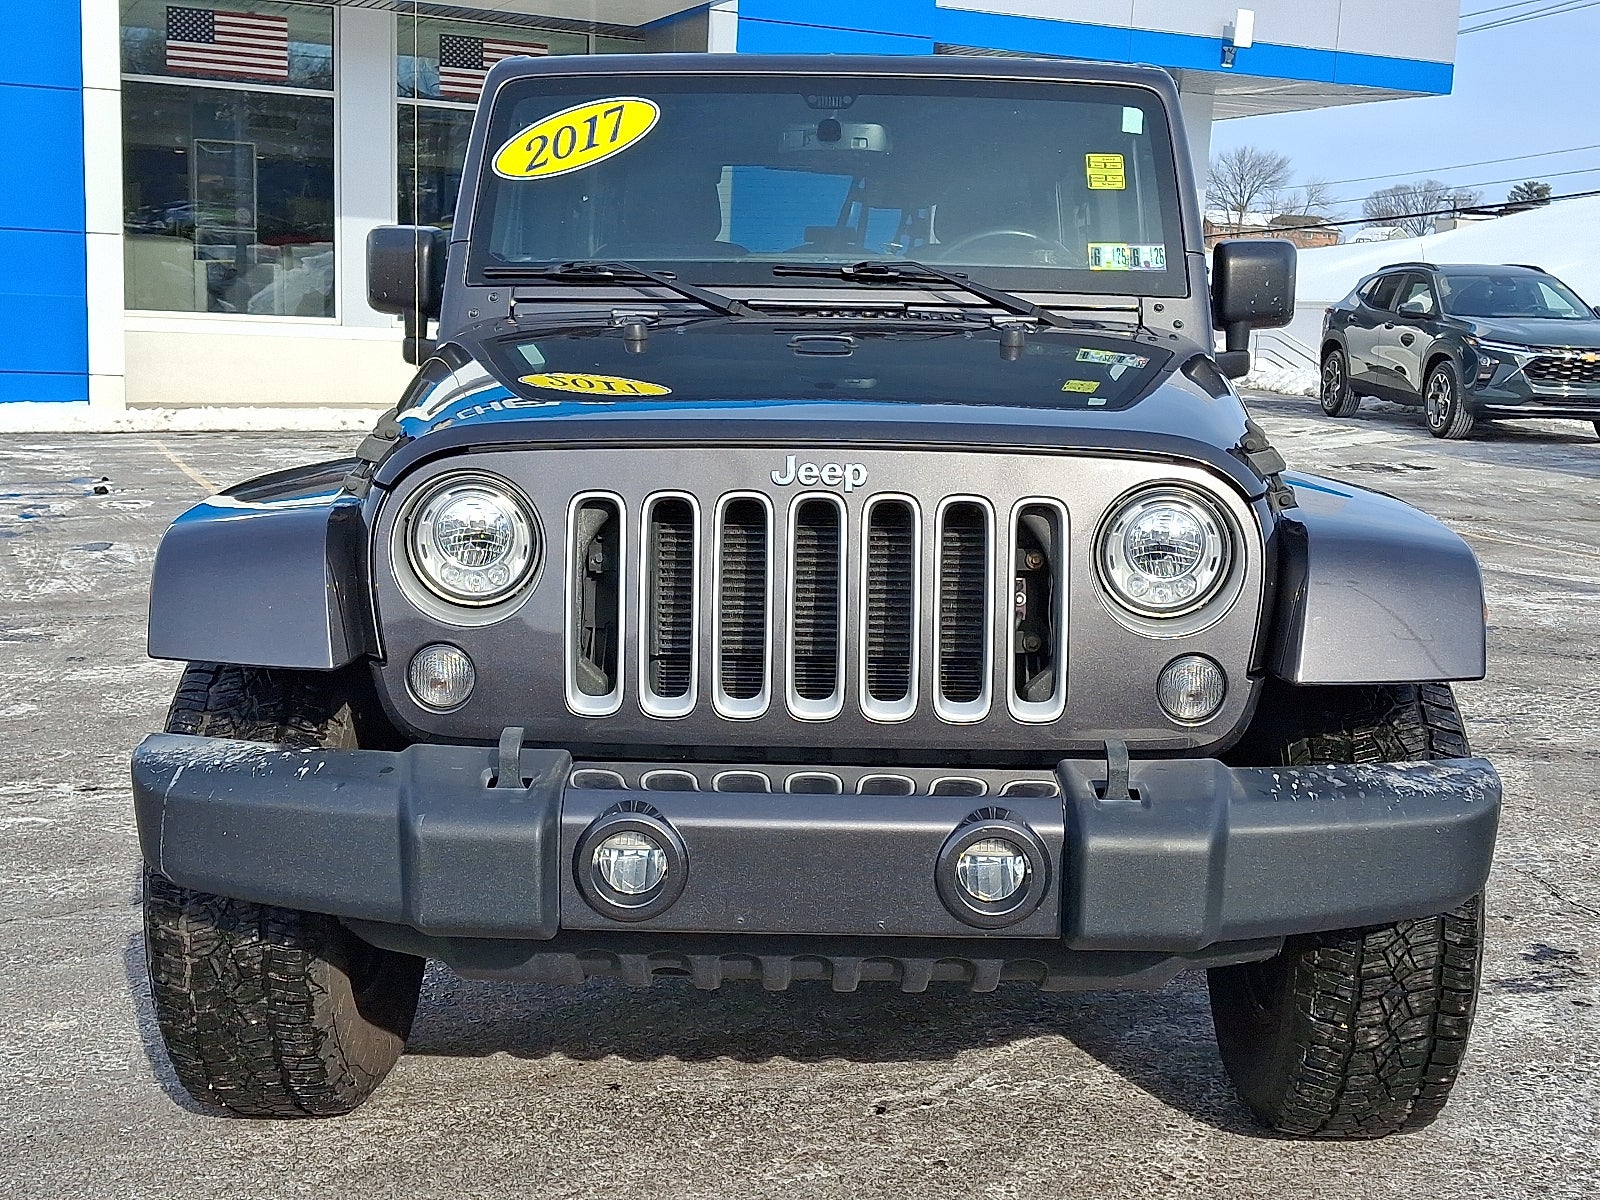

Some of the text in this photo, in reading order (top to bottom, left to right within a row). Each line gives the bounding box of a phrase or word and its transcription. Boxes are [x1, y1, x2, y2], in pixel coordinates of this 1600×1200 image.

[525, 104, 625, 172] 2017
[1093, 247, 1127, 267] 6 25
[1132, 247, 1165, 267] 6 26
[770, 454, 868, 493] Jeep
